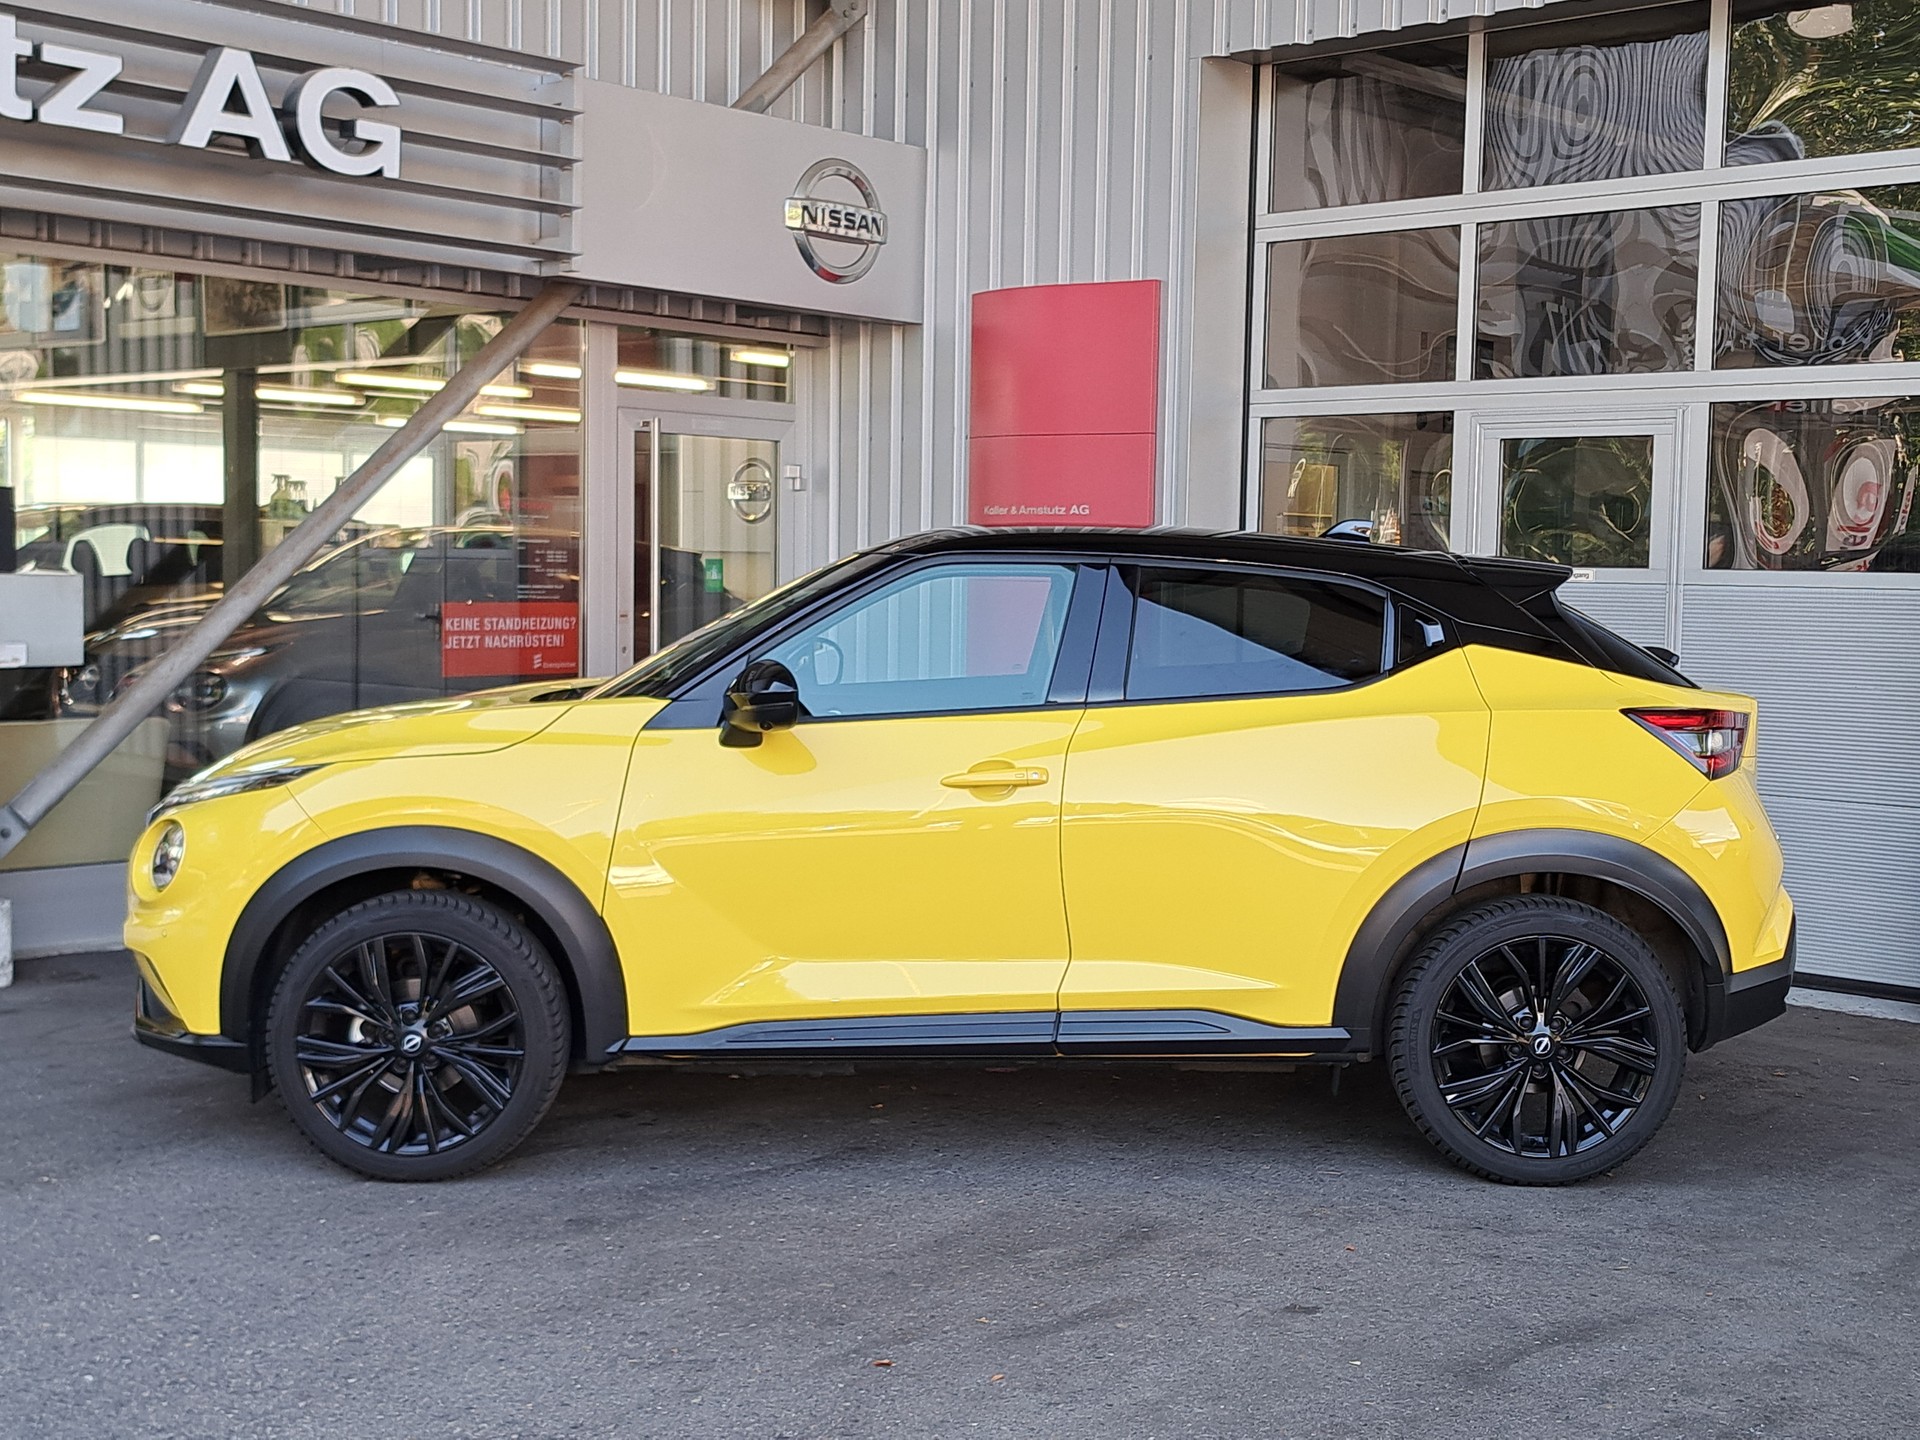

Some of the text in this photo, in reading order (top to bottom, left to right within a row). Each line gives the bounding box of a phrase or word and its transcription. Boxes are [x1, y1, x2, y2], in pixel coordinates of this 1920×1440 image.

[178, 47, 401, 179] AG
[801, 204, 885, 237] NISSAN
[1010, 505, 1017, 515] &
[1019, 505, 1066, 515] Amstutz
[1069, 504, 1090, 515] AG
[445, 616, 577, 632] KEINE STANDHEIZUNG?
[445, 632, 565, 649] JETZT NACHRÜSTEN!
